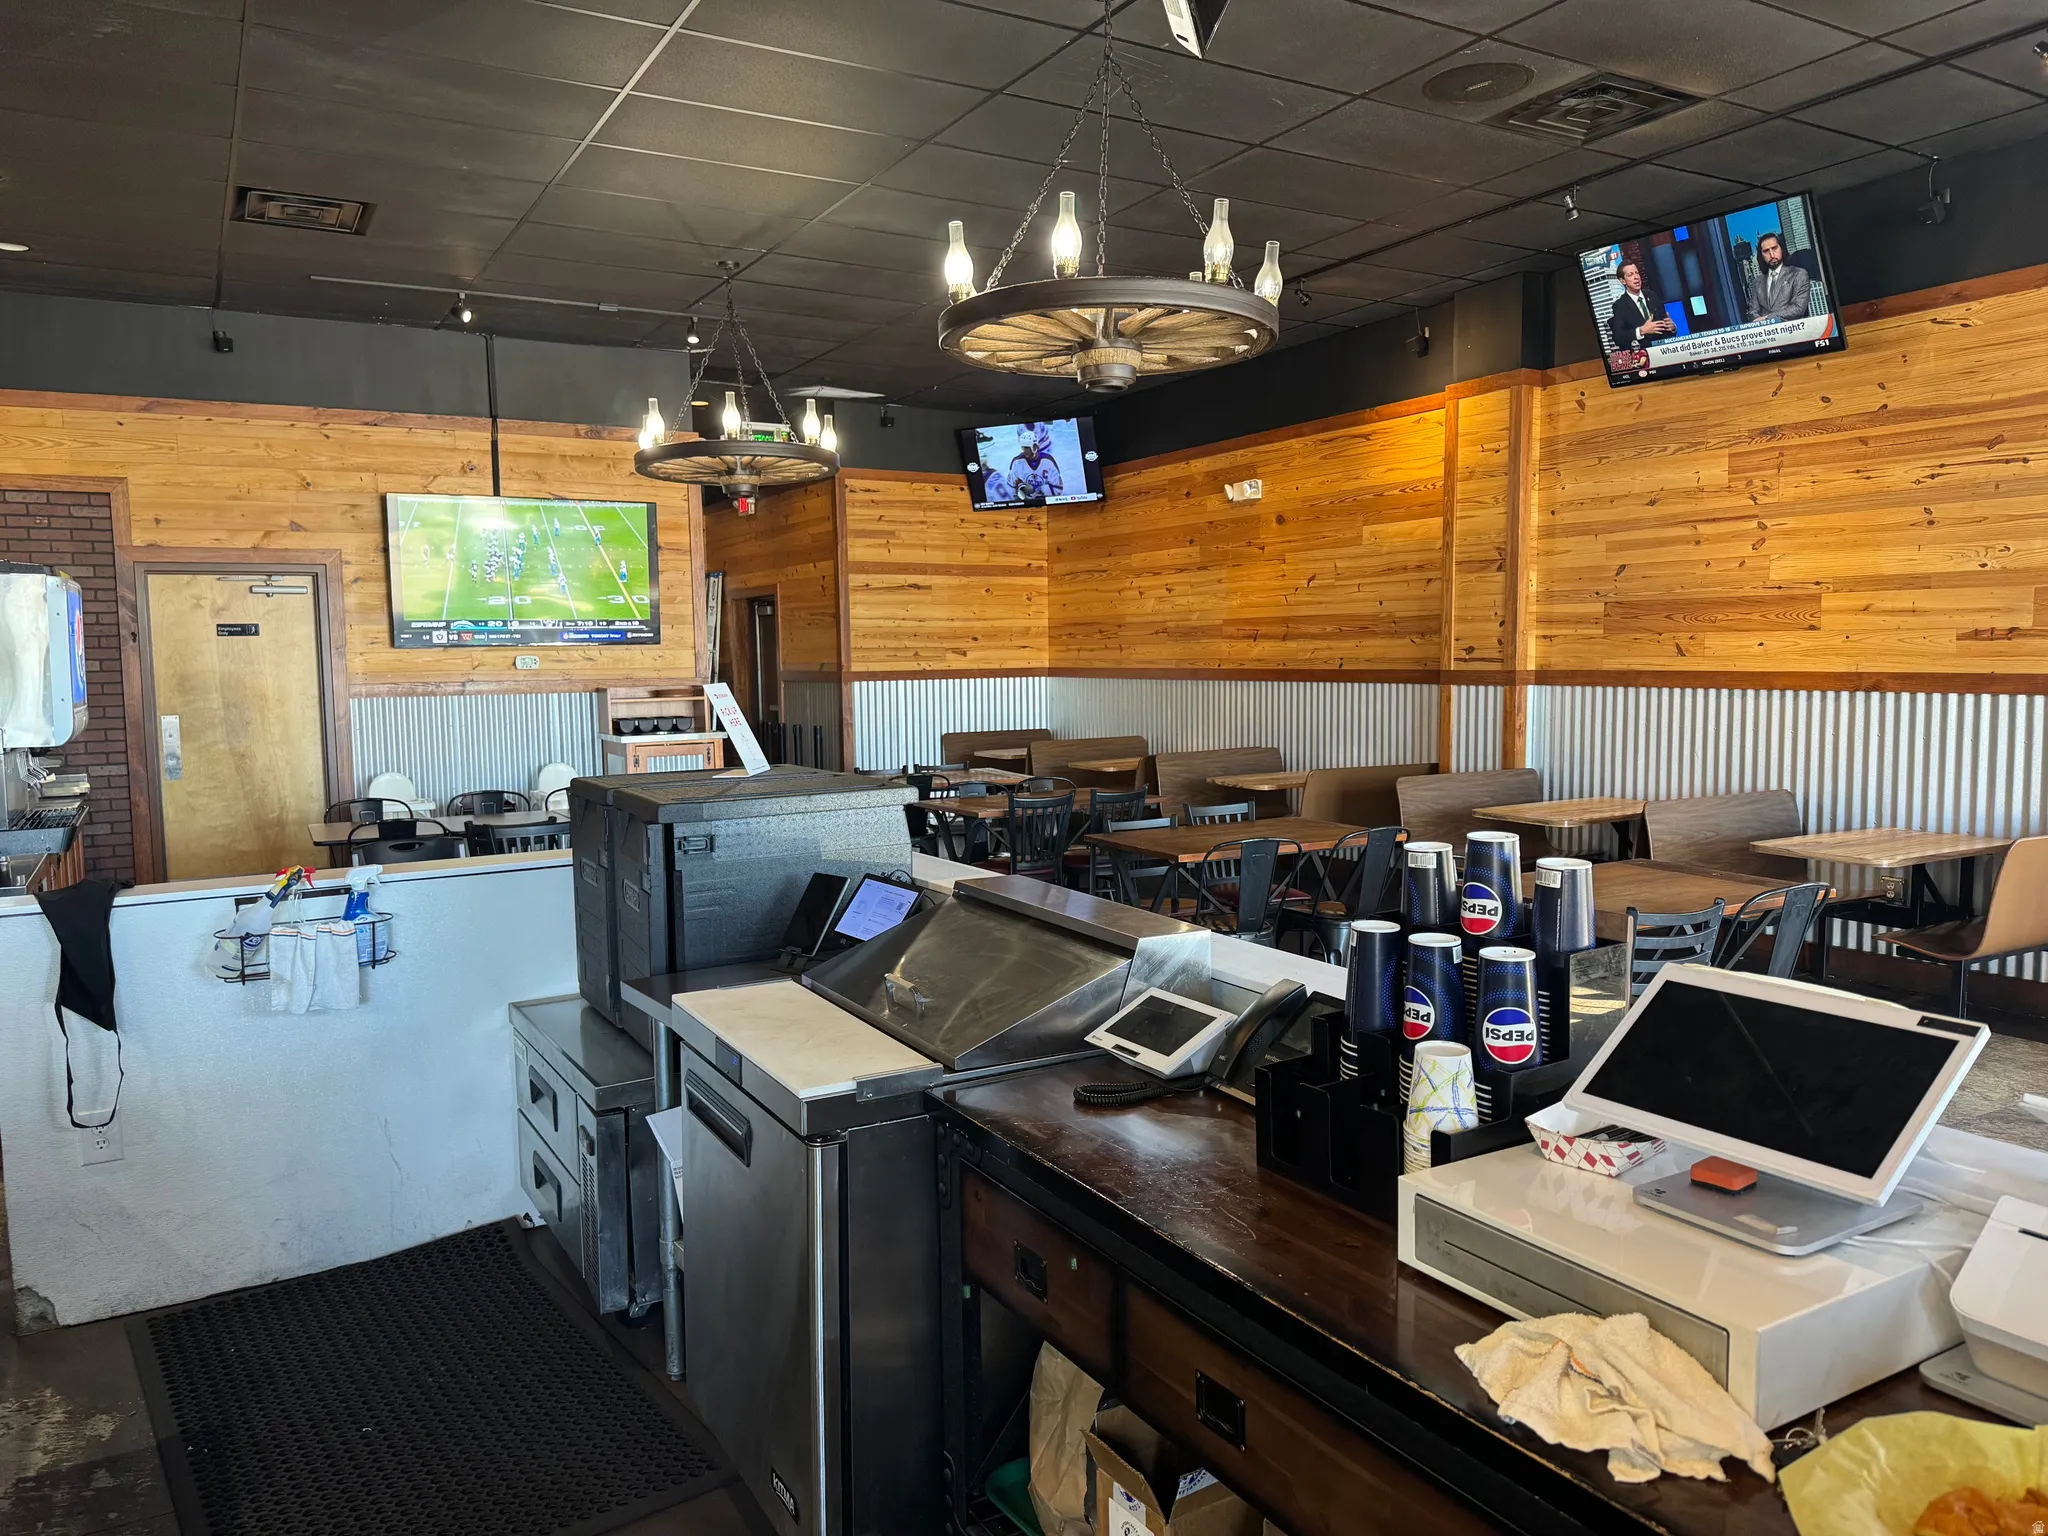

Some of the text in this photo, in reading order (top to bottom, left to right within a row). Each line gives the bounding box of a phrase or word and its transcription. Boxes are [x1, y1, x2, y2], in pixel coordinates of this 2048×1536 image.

[1740, 321, 1760, 330] IMPROVE
[1660, 322, 1805, 356] What did Baker & Bucs prove last night?
[1814, 339, 1830, 348] FS1
[1462, 900, 1499, 917] PEPS
[1403, 1004, 1431, 1023] PEP
[1485, 1027, 1535, 1042] PEPSI
